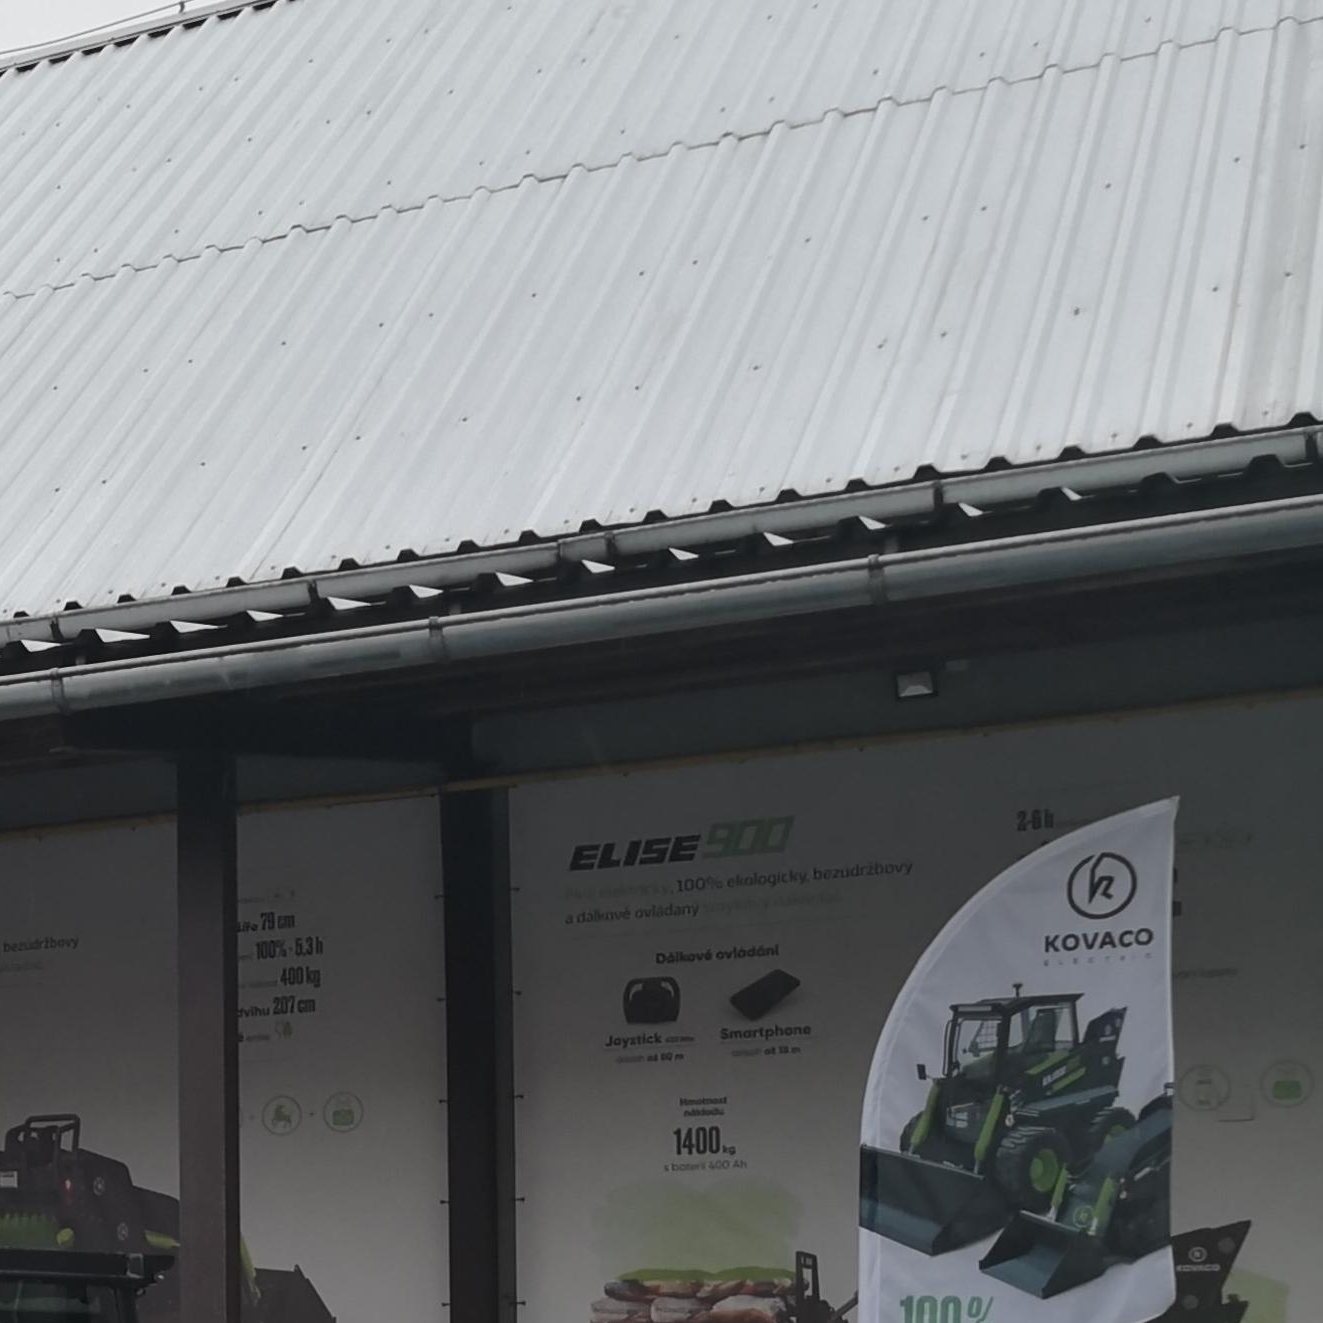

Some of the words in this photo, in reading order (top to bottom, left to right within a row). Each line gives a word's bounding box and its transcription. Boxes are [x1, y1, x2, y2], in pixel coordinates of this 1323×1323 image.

[1044, 928, 1153, 952] KOVACO
[605, 1033, 662, 1049] Joystick
[720, 1025, 811, 1041] Smartphone
[673, 1126, 720, 1155] 1400
[722, 1144, 736, 1155] kg
